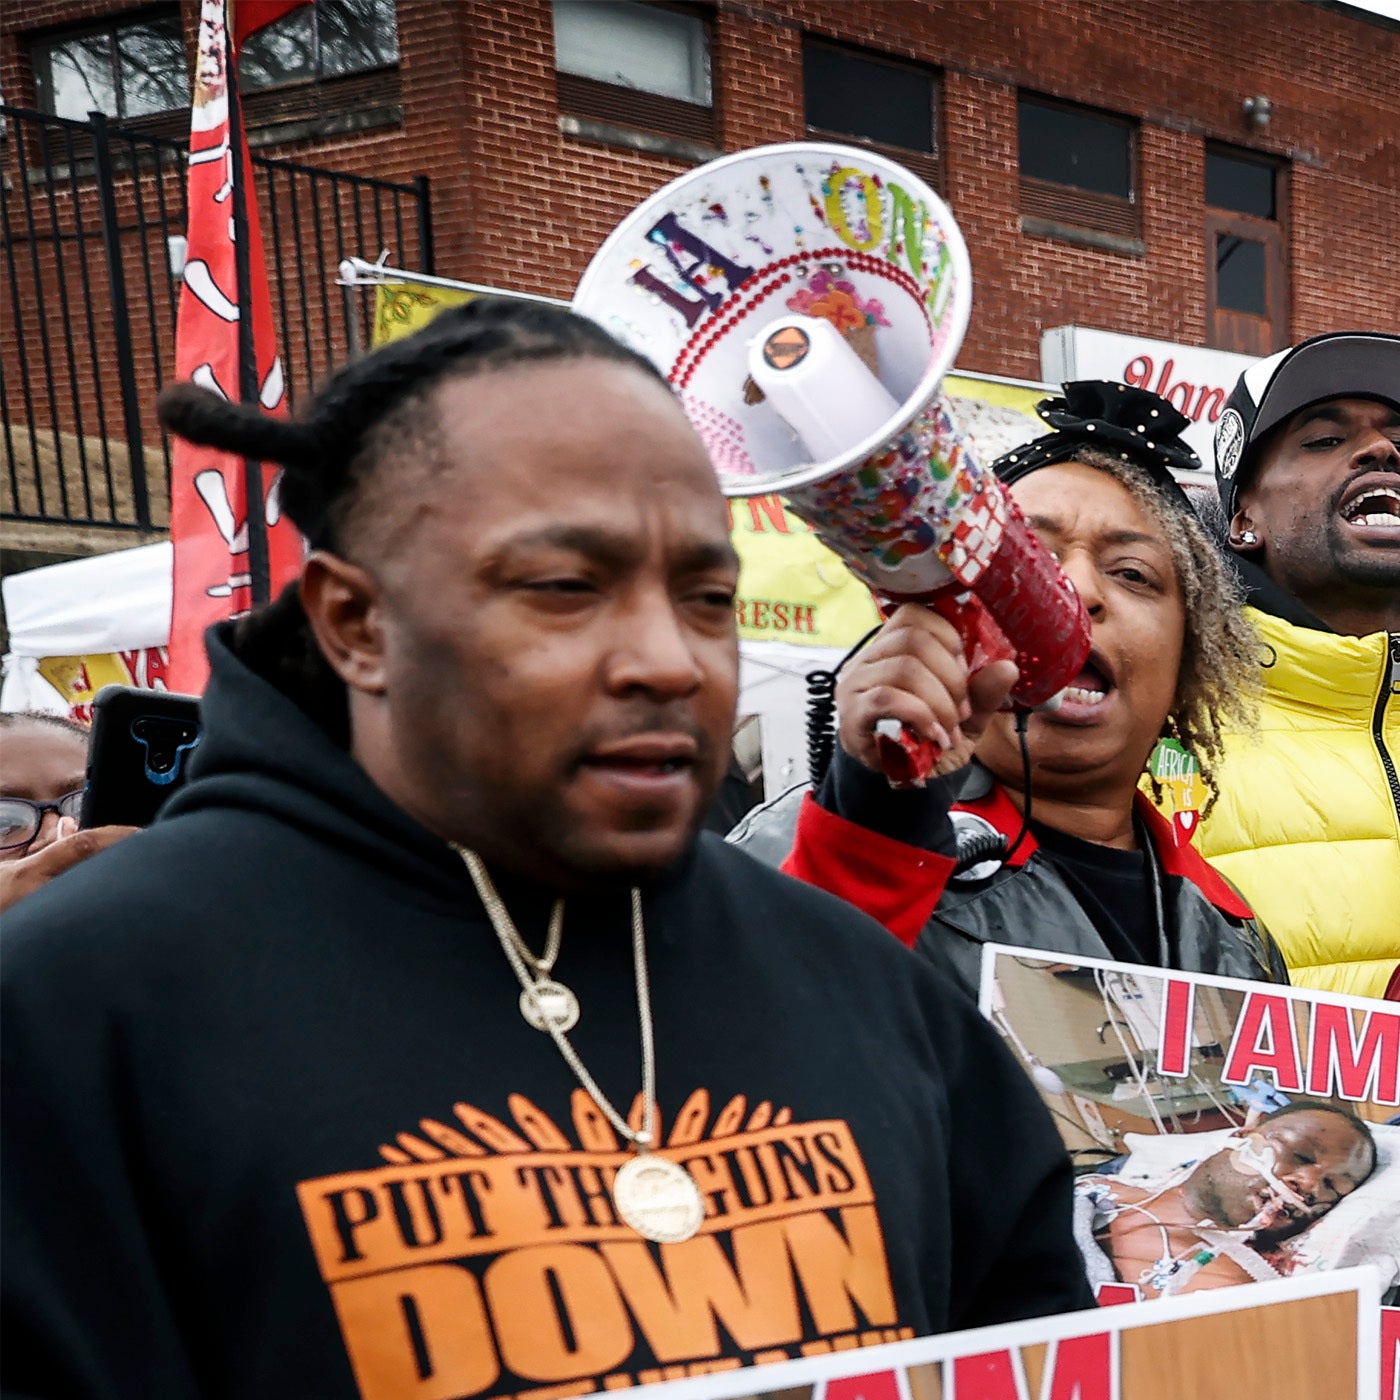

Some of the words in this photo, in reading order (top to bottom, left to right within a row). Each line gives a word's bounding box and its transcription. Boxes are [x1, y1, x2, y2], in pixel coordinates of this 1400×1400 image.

[735, 600, 817, 633] RESH
[1157, 744, 1194, 787] AFRICA
[1182, 788, 1193, 807] IS
[1157, 980, 1196, 1077] I
[322, 1168, 496, 1263] PUT
[516, 1163, 621, 1231] TH
[681, 1130, 859, 1221] GUNS
